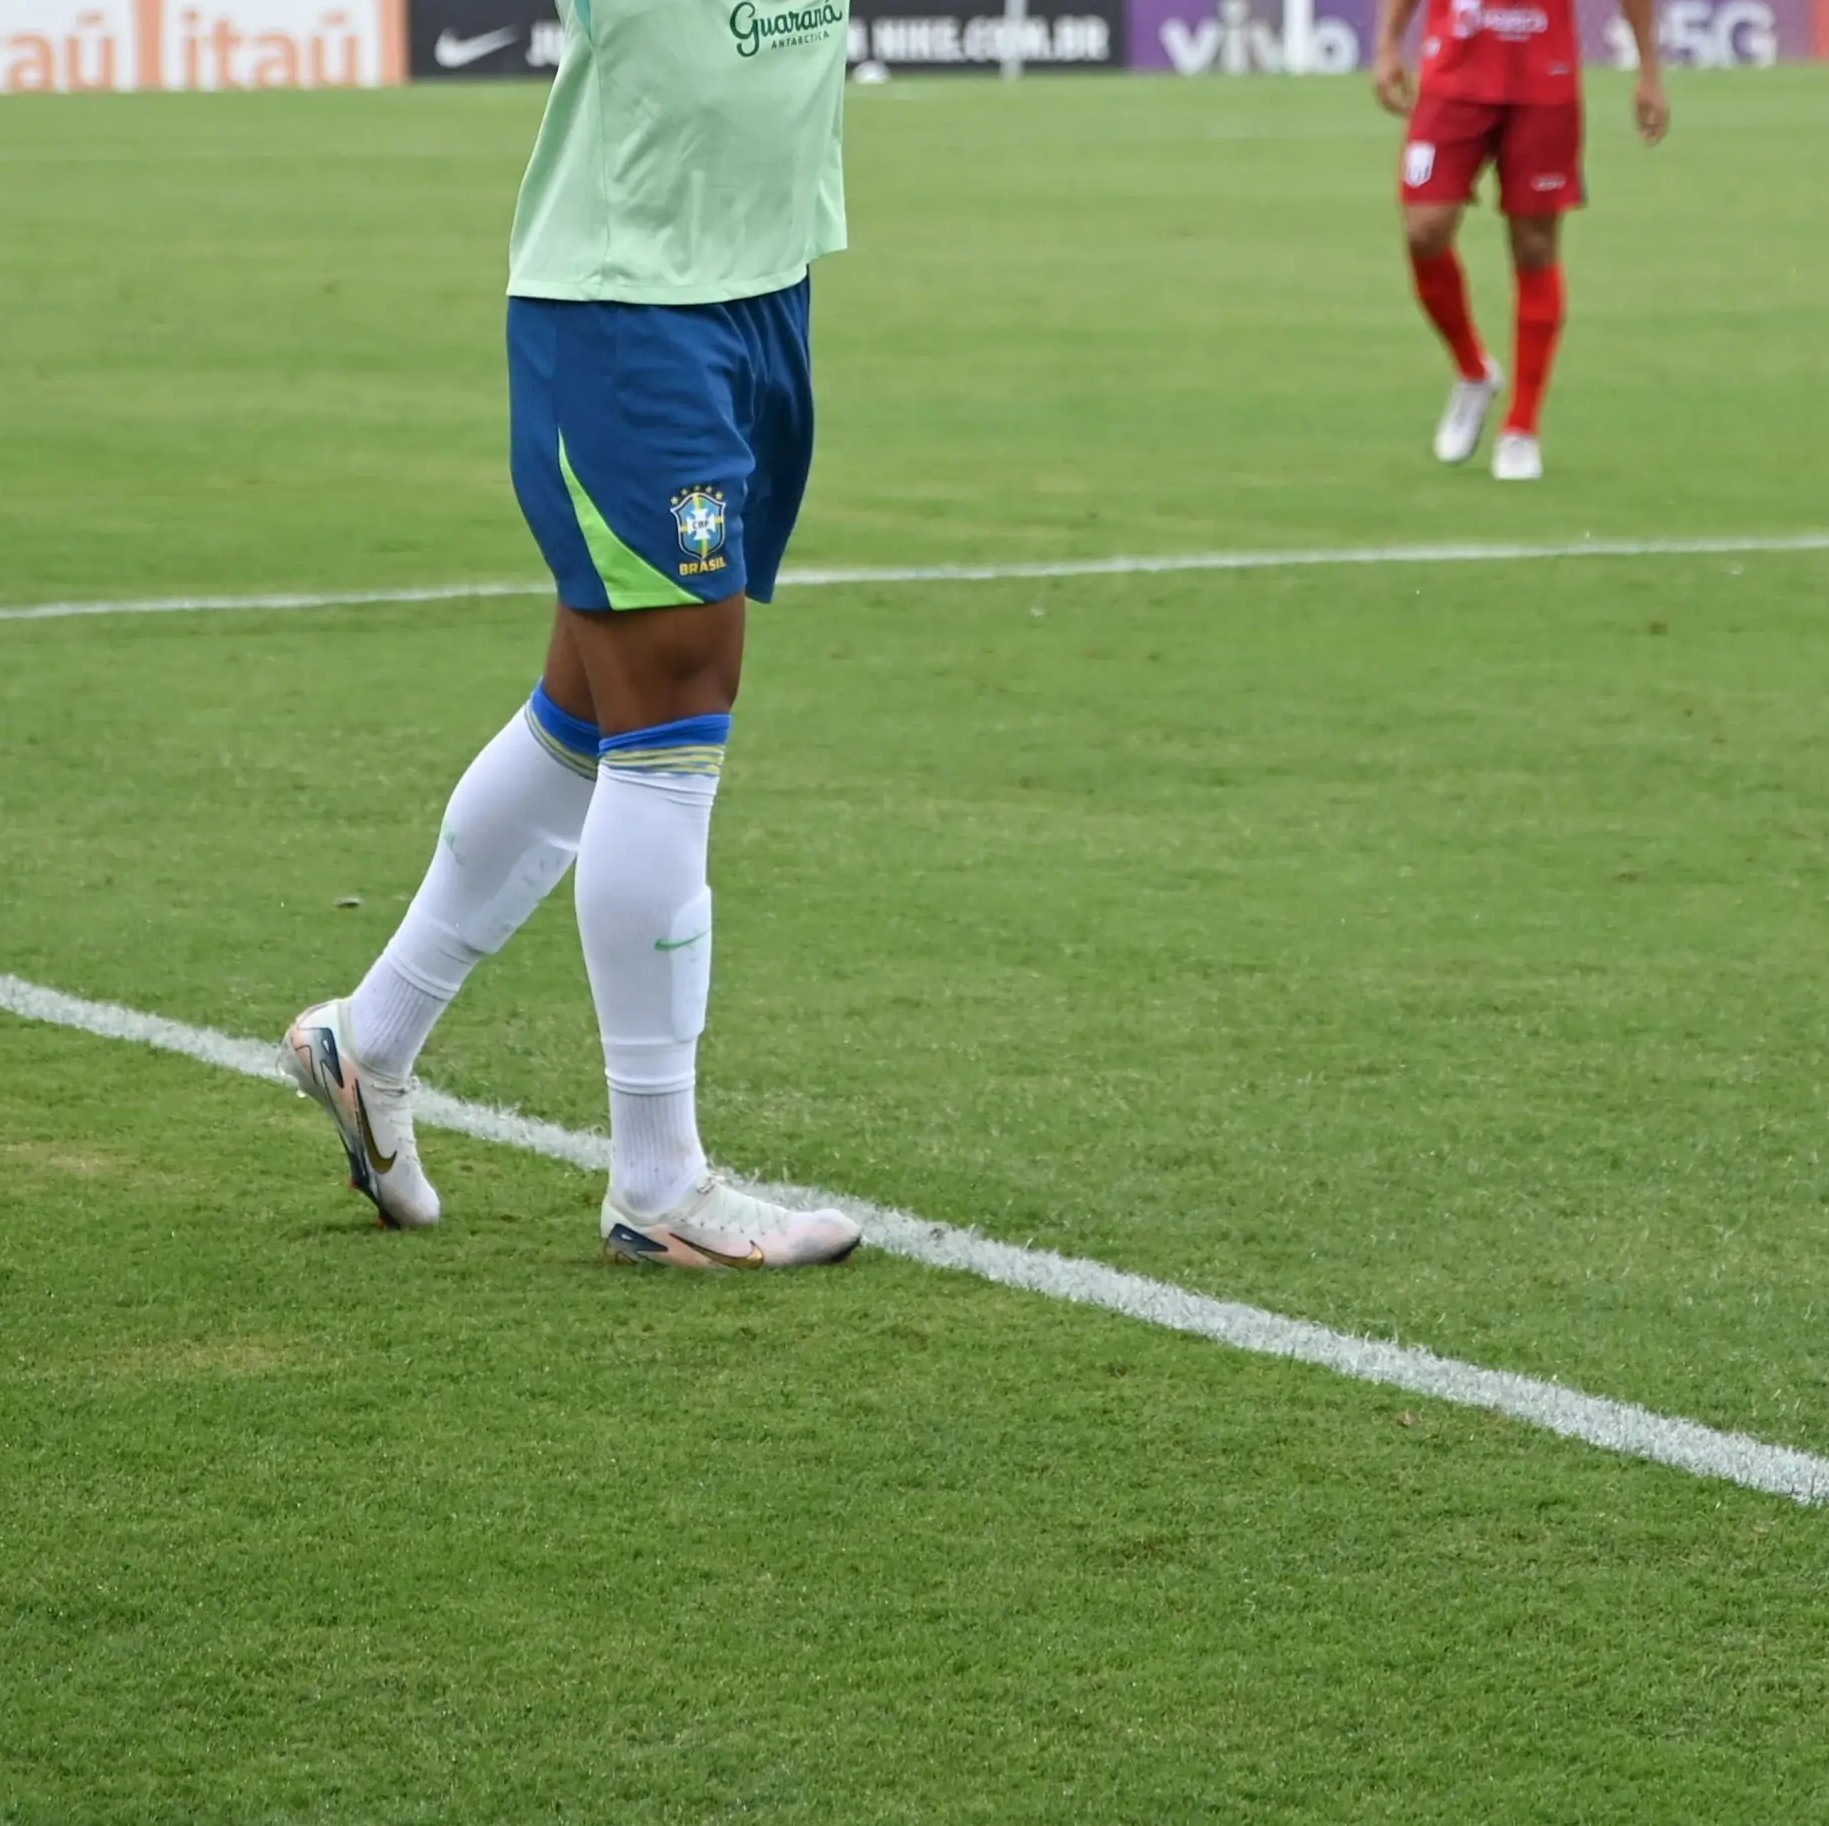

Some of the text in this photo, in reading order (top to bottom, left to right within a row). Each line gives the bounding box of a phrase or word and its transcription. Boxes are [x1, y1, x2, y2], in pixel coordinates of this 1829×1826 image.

[184, 8, 358, 88] itaú
[771, 30, 830, 51] ANTARCTICA
[680, 558, 726, 576] BRASIL
